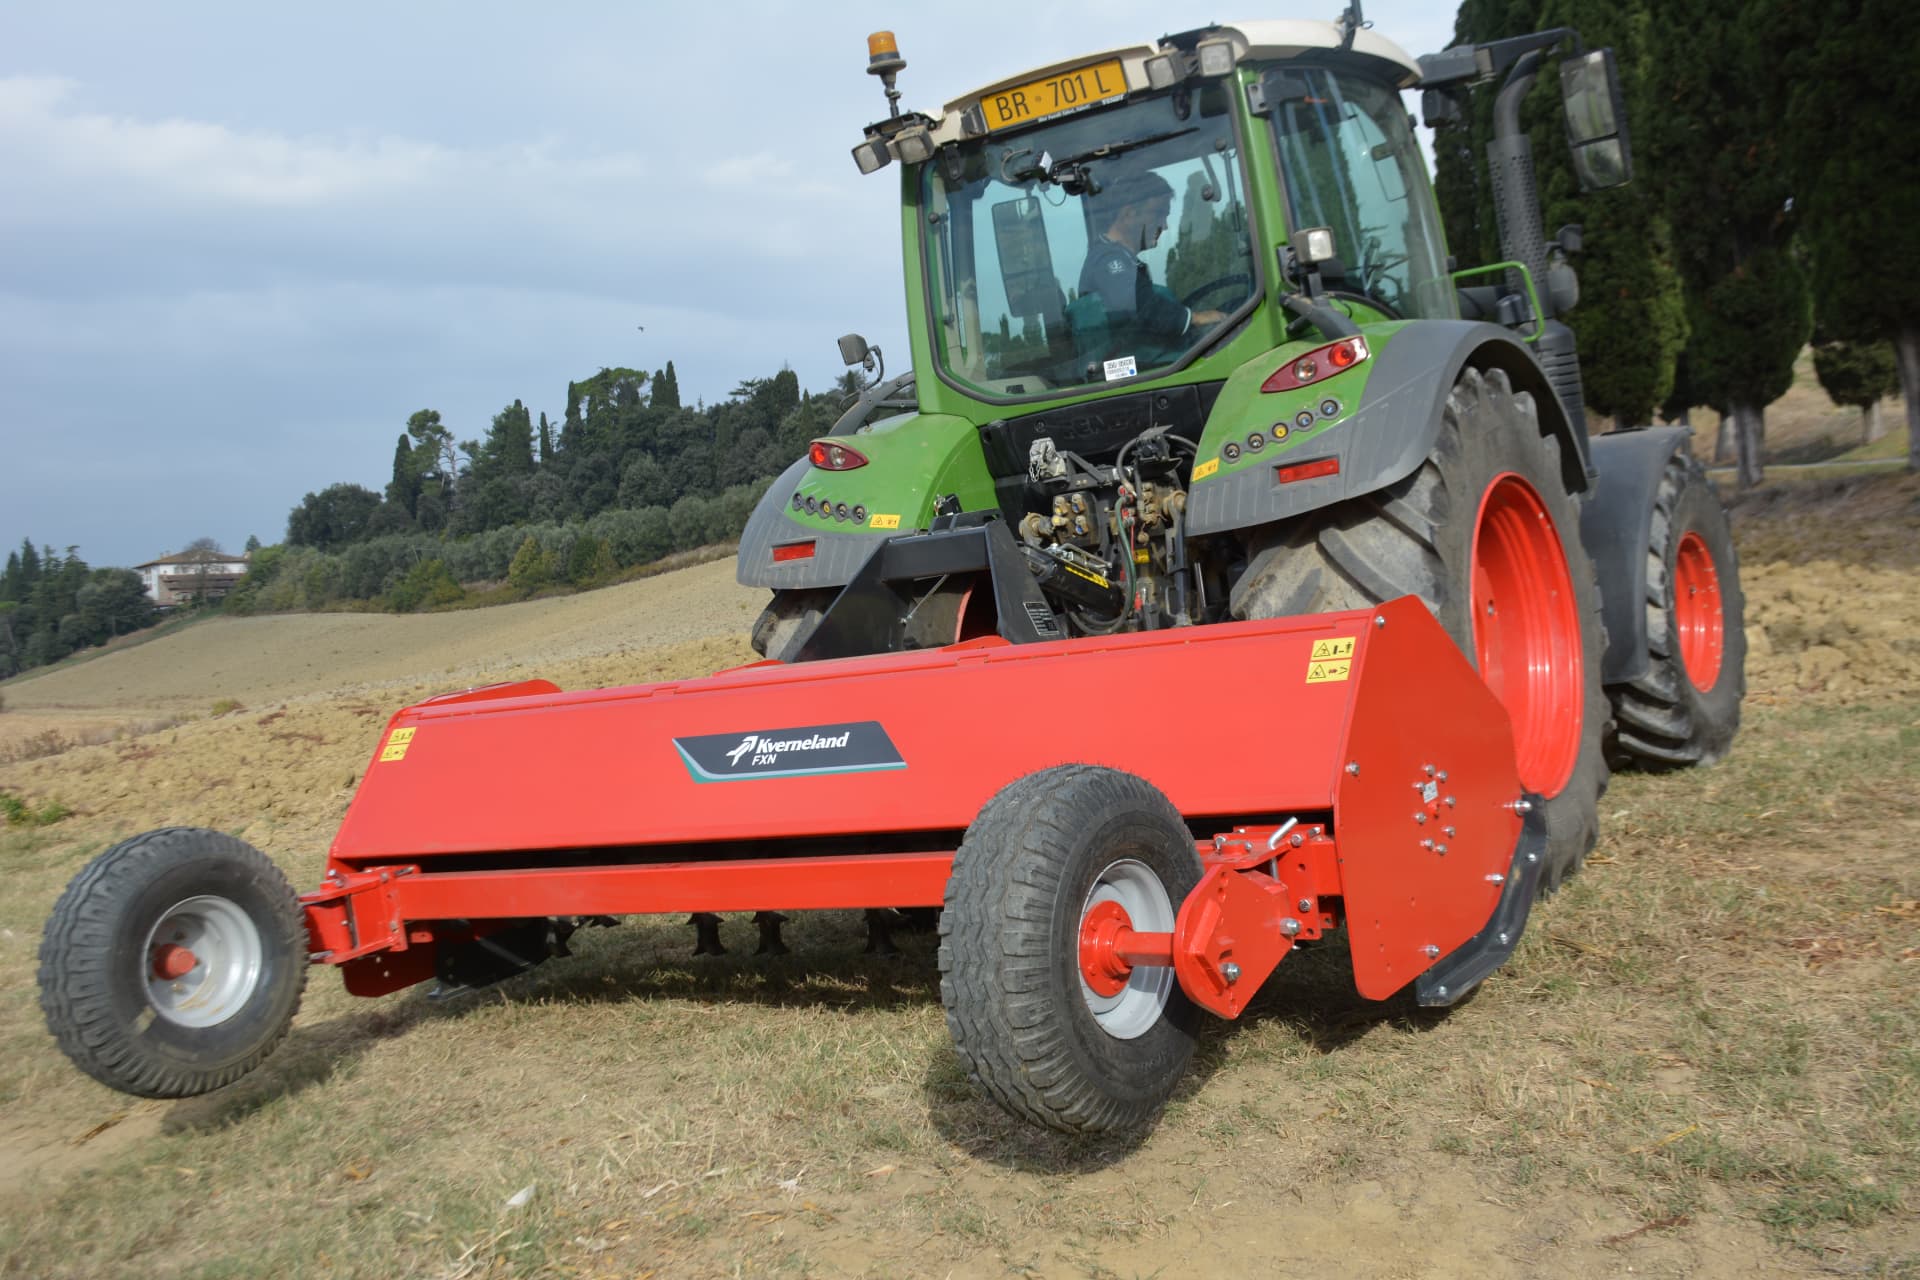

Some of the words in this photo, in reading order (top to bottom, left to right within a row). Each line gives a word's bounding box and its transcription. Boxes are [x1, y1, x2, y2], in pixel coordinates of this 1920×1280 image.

[996, 92, 1030, 121] BR
[1046, 75, 1087, 106] 701
[1094, 70, 1111, 93] L
[756, 732, 850, 753] Kverneland
[752, 754, 777, 766] FXN
